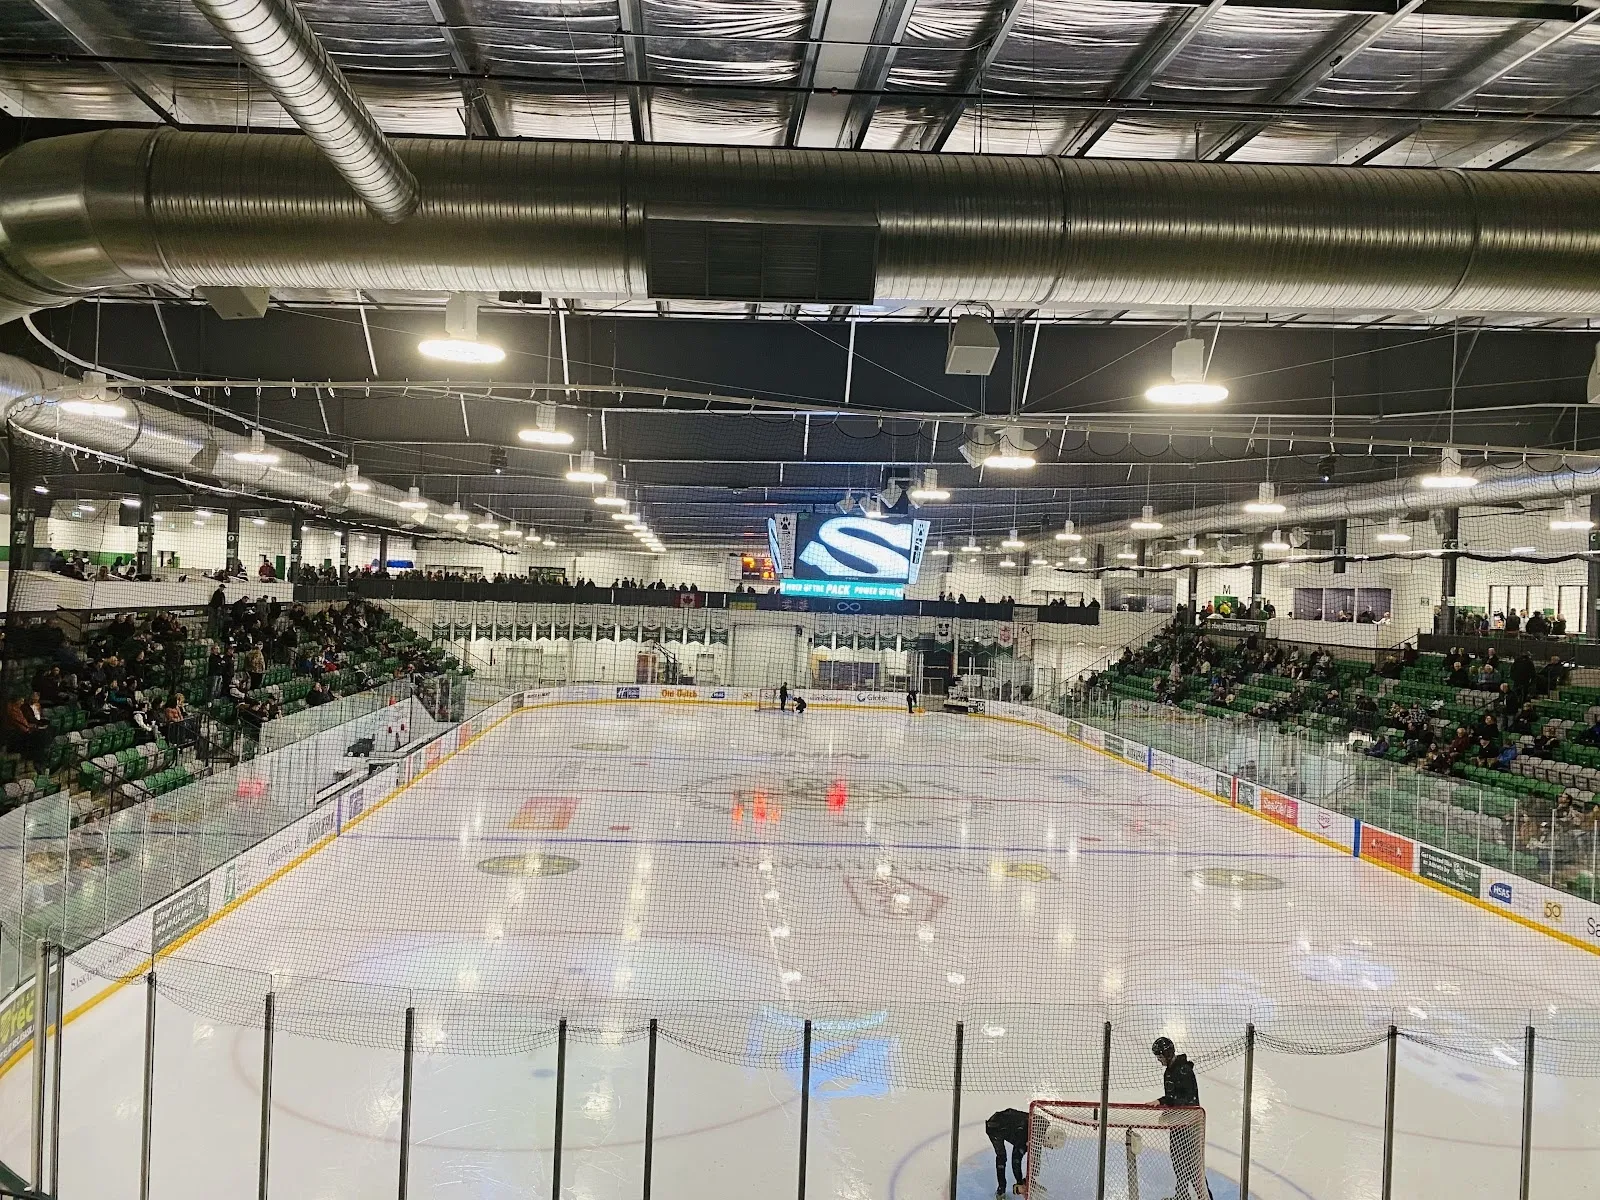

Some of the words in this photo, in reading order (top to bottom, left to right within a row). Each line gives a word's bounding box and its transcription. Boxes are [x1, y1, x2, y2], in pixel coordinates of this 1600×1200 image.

[825, 584, 851, 595] PACK
[1222, 584, 1231, 595] M
[661, 689, 674, 698] Old
[1493, 885, 1510, 899] HSAS
